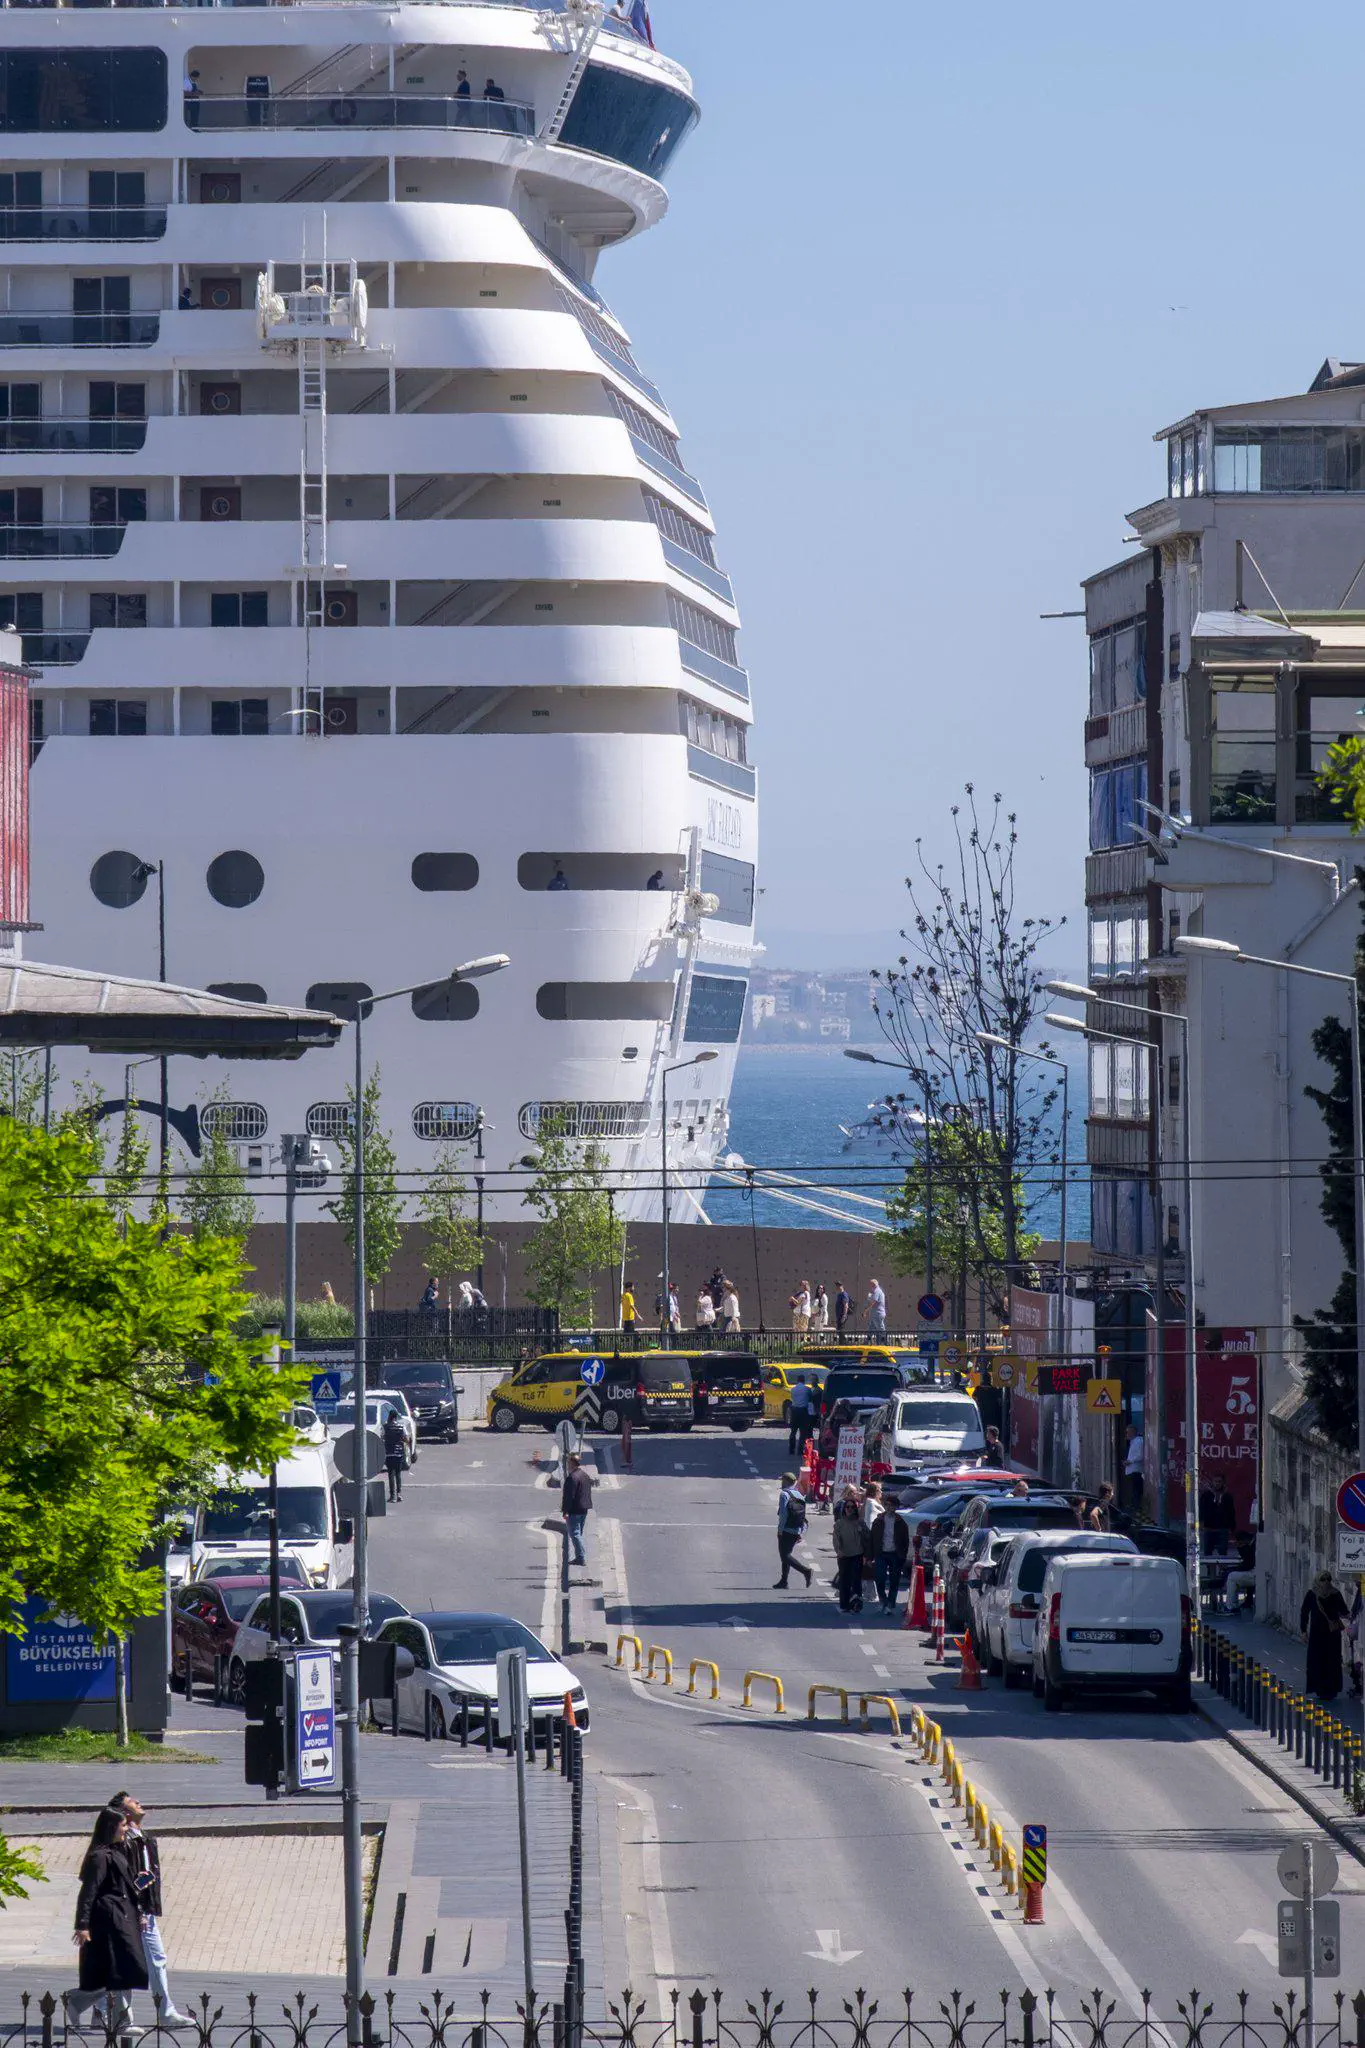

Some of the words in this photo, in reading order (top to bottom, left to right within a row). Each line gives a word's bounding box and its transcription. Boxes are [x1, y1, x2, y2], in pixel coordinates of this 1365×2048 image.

[1052, 1368, 1080, 1379] PARK
[1052, 1379, 1080, 1391] VALE
[607, 1384, 636, 1400] Uber
[1226, 1376, 1256, 1415] 5.
[840, 1435, 862, 1444] CLASS
[842, 1448, 856, 1457] ONE
[840, 1461, 857, 1471] VALE
[1341, 1536, 1355, 1544] Yol
[35, 1634, 93, 1644] İSTANBU
[35, 1661, 103, 1672] BELEDİYESİ
